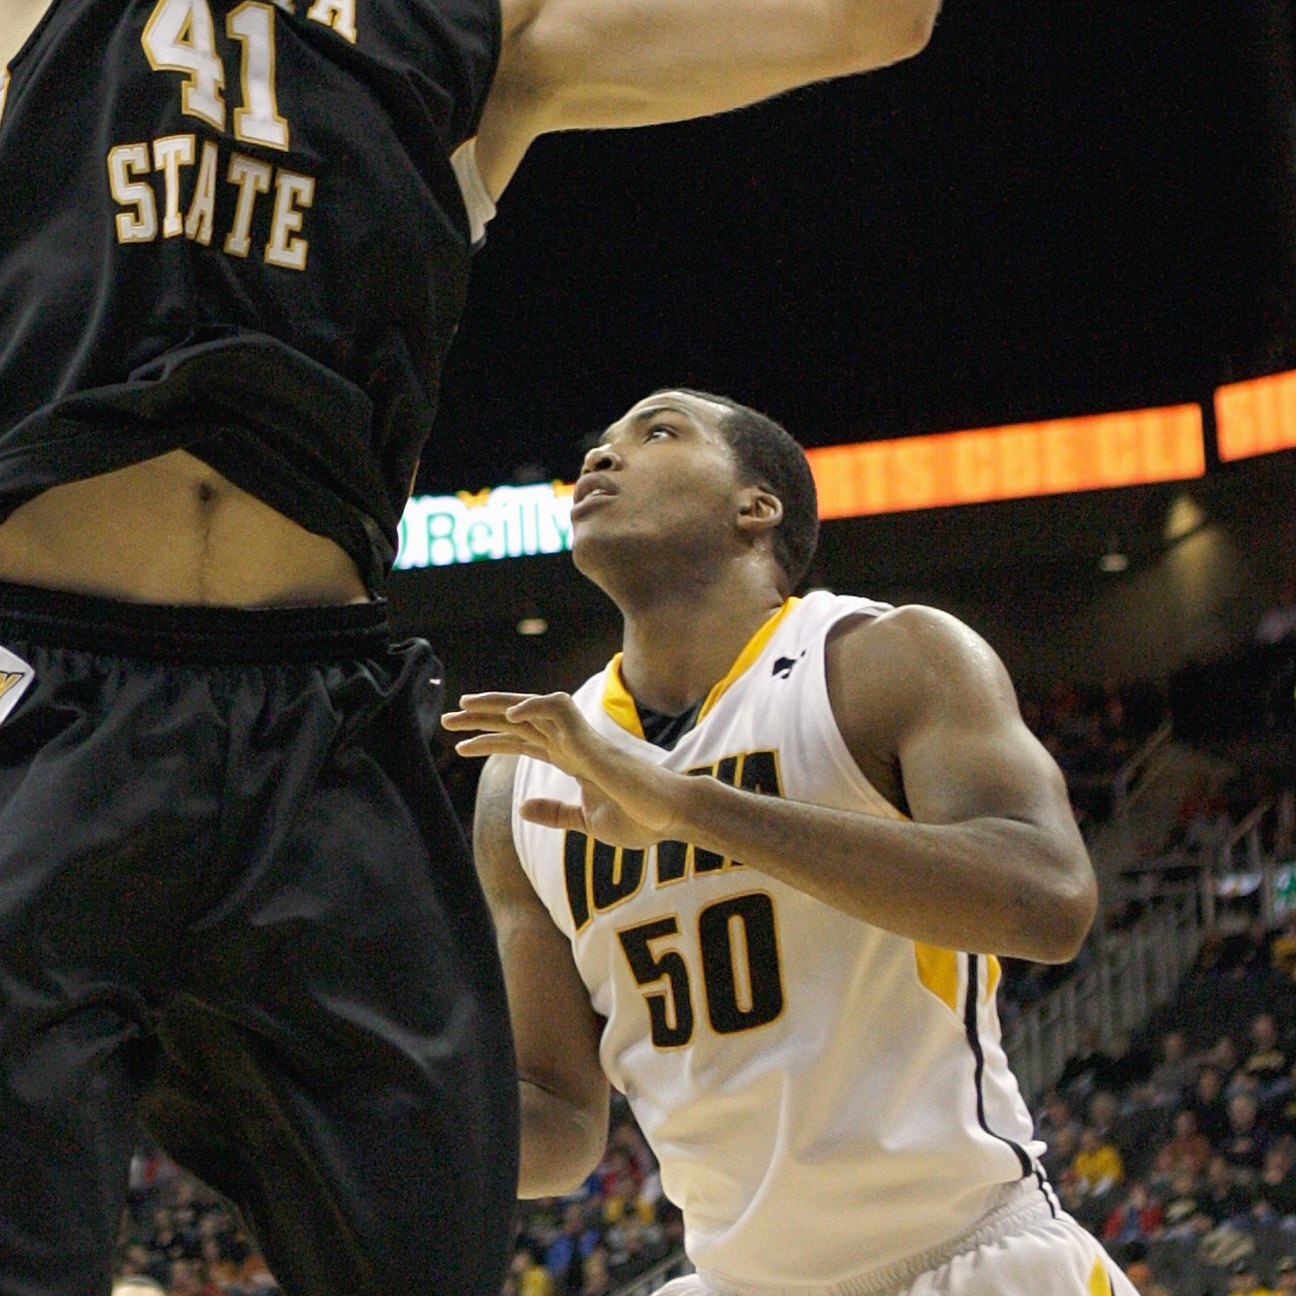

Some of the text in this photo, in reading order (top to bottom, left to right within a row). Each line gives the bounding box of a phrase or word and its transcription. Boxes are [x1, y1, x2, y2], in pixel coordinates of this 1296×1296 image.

[107, 133, 316, 271] STATE
[396, 498, 574, 566] Reilly
[615, 889, 788, 1054] 50
